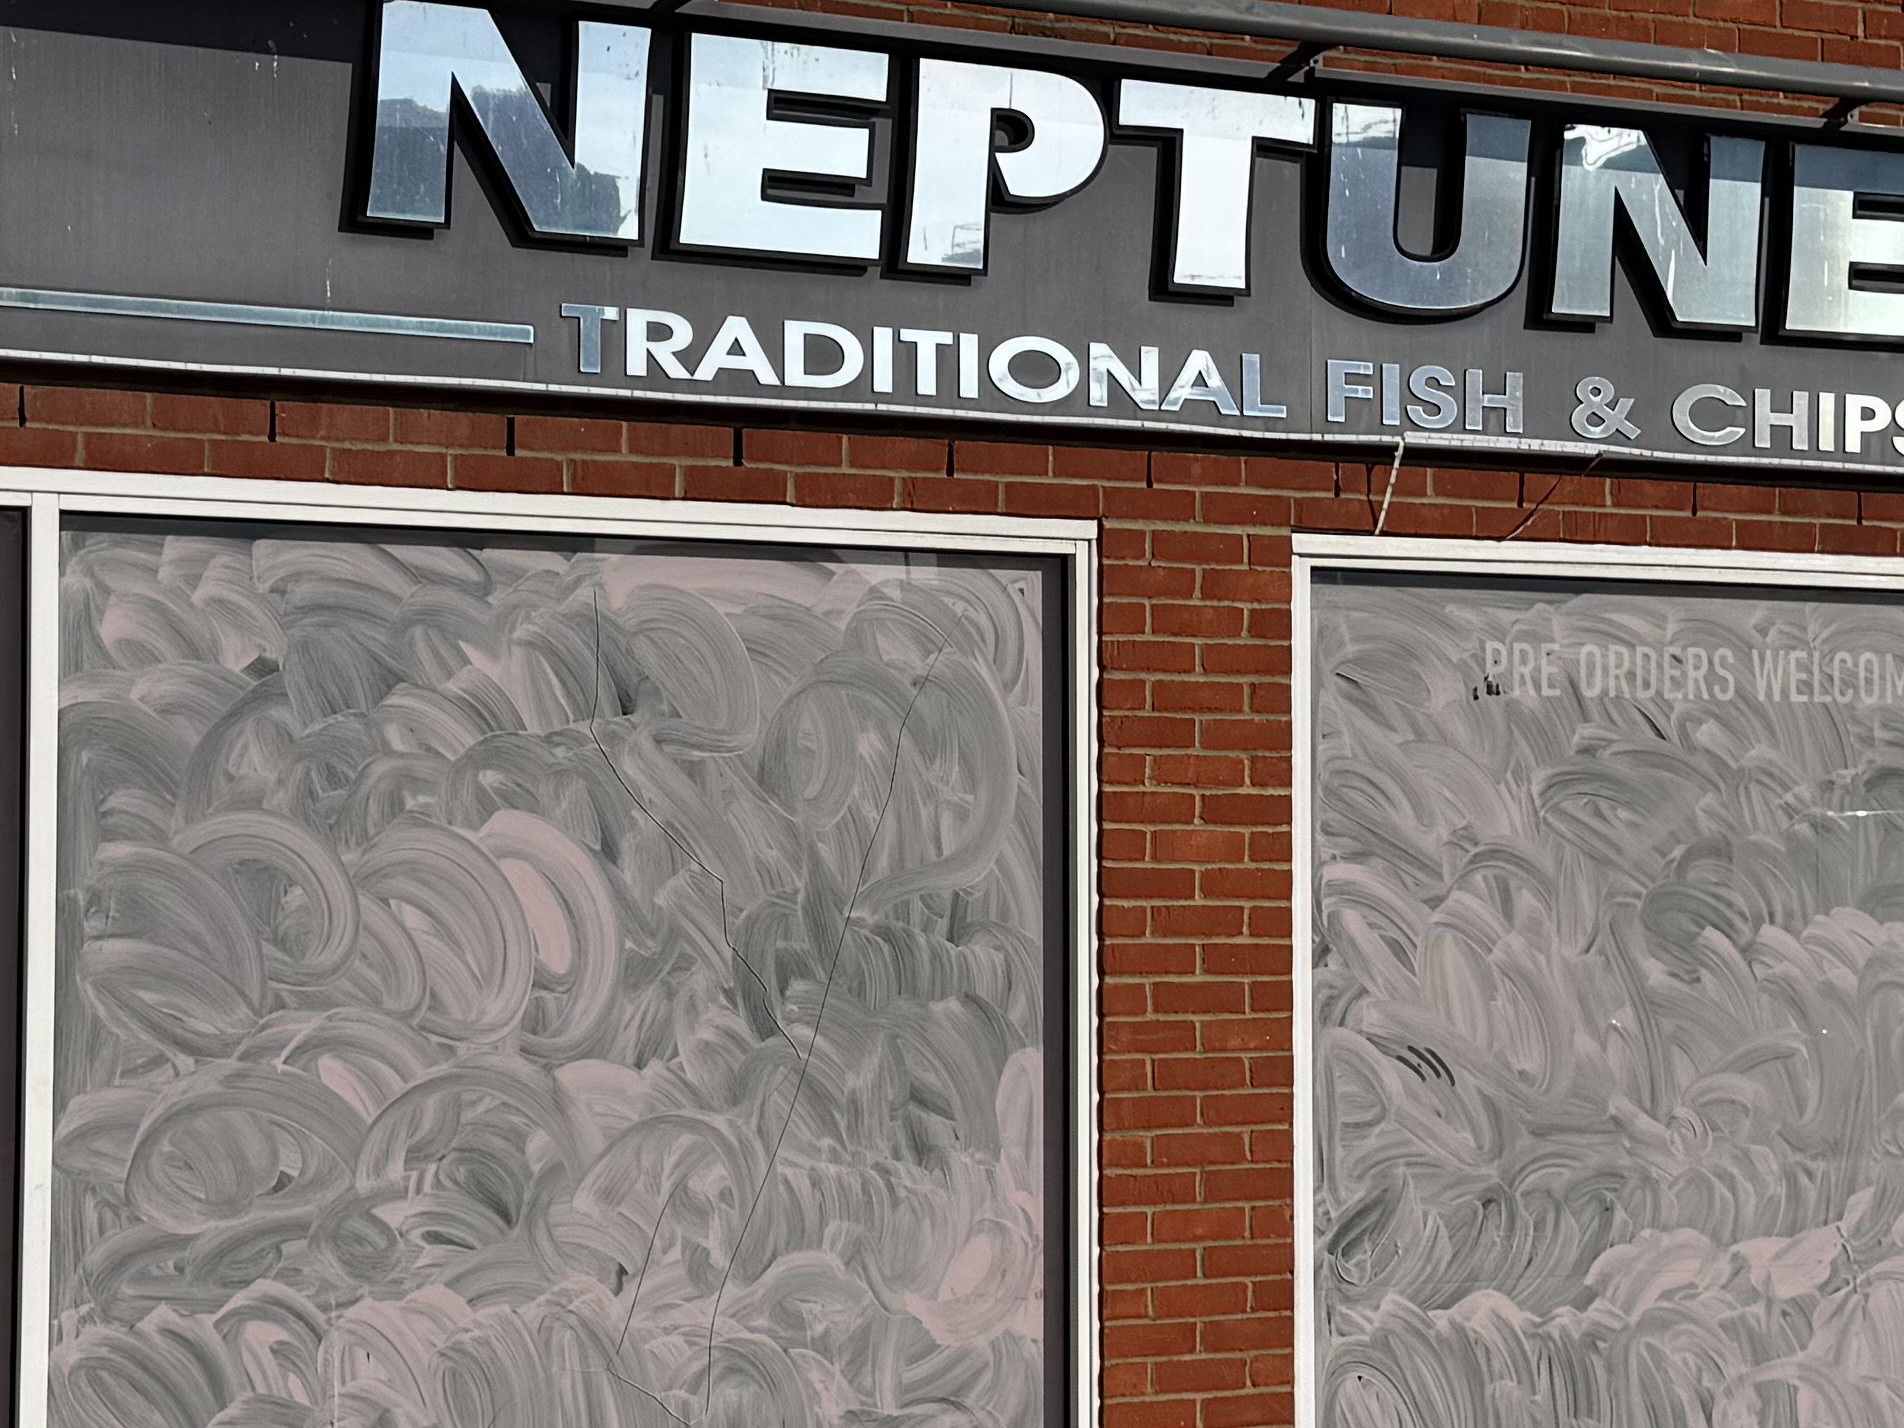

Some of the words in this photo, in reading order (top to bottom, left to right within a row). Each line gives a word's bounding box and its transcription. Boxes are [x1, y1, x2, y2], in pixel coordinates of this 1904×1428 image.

[561, 302, 1287, 419] TRADITIONAL
[1326, 358, 1524, 434] FISH
[1570, 375, 1641, 440] &
[1485, 640, 1561, 698] PRE
[1579, 643, 1736, 702] ORDERS
